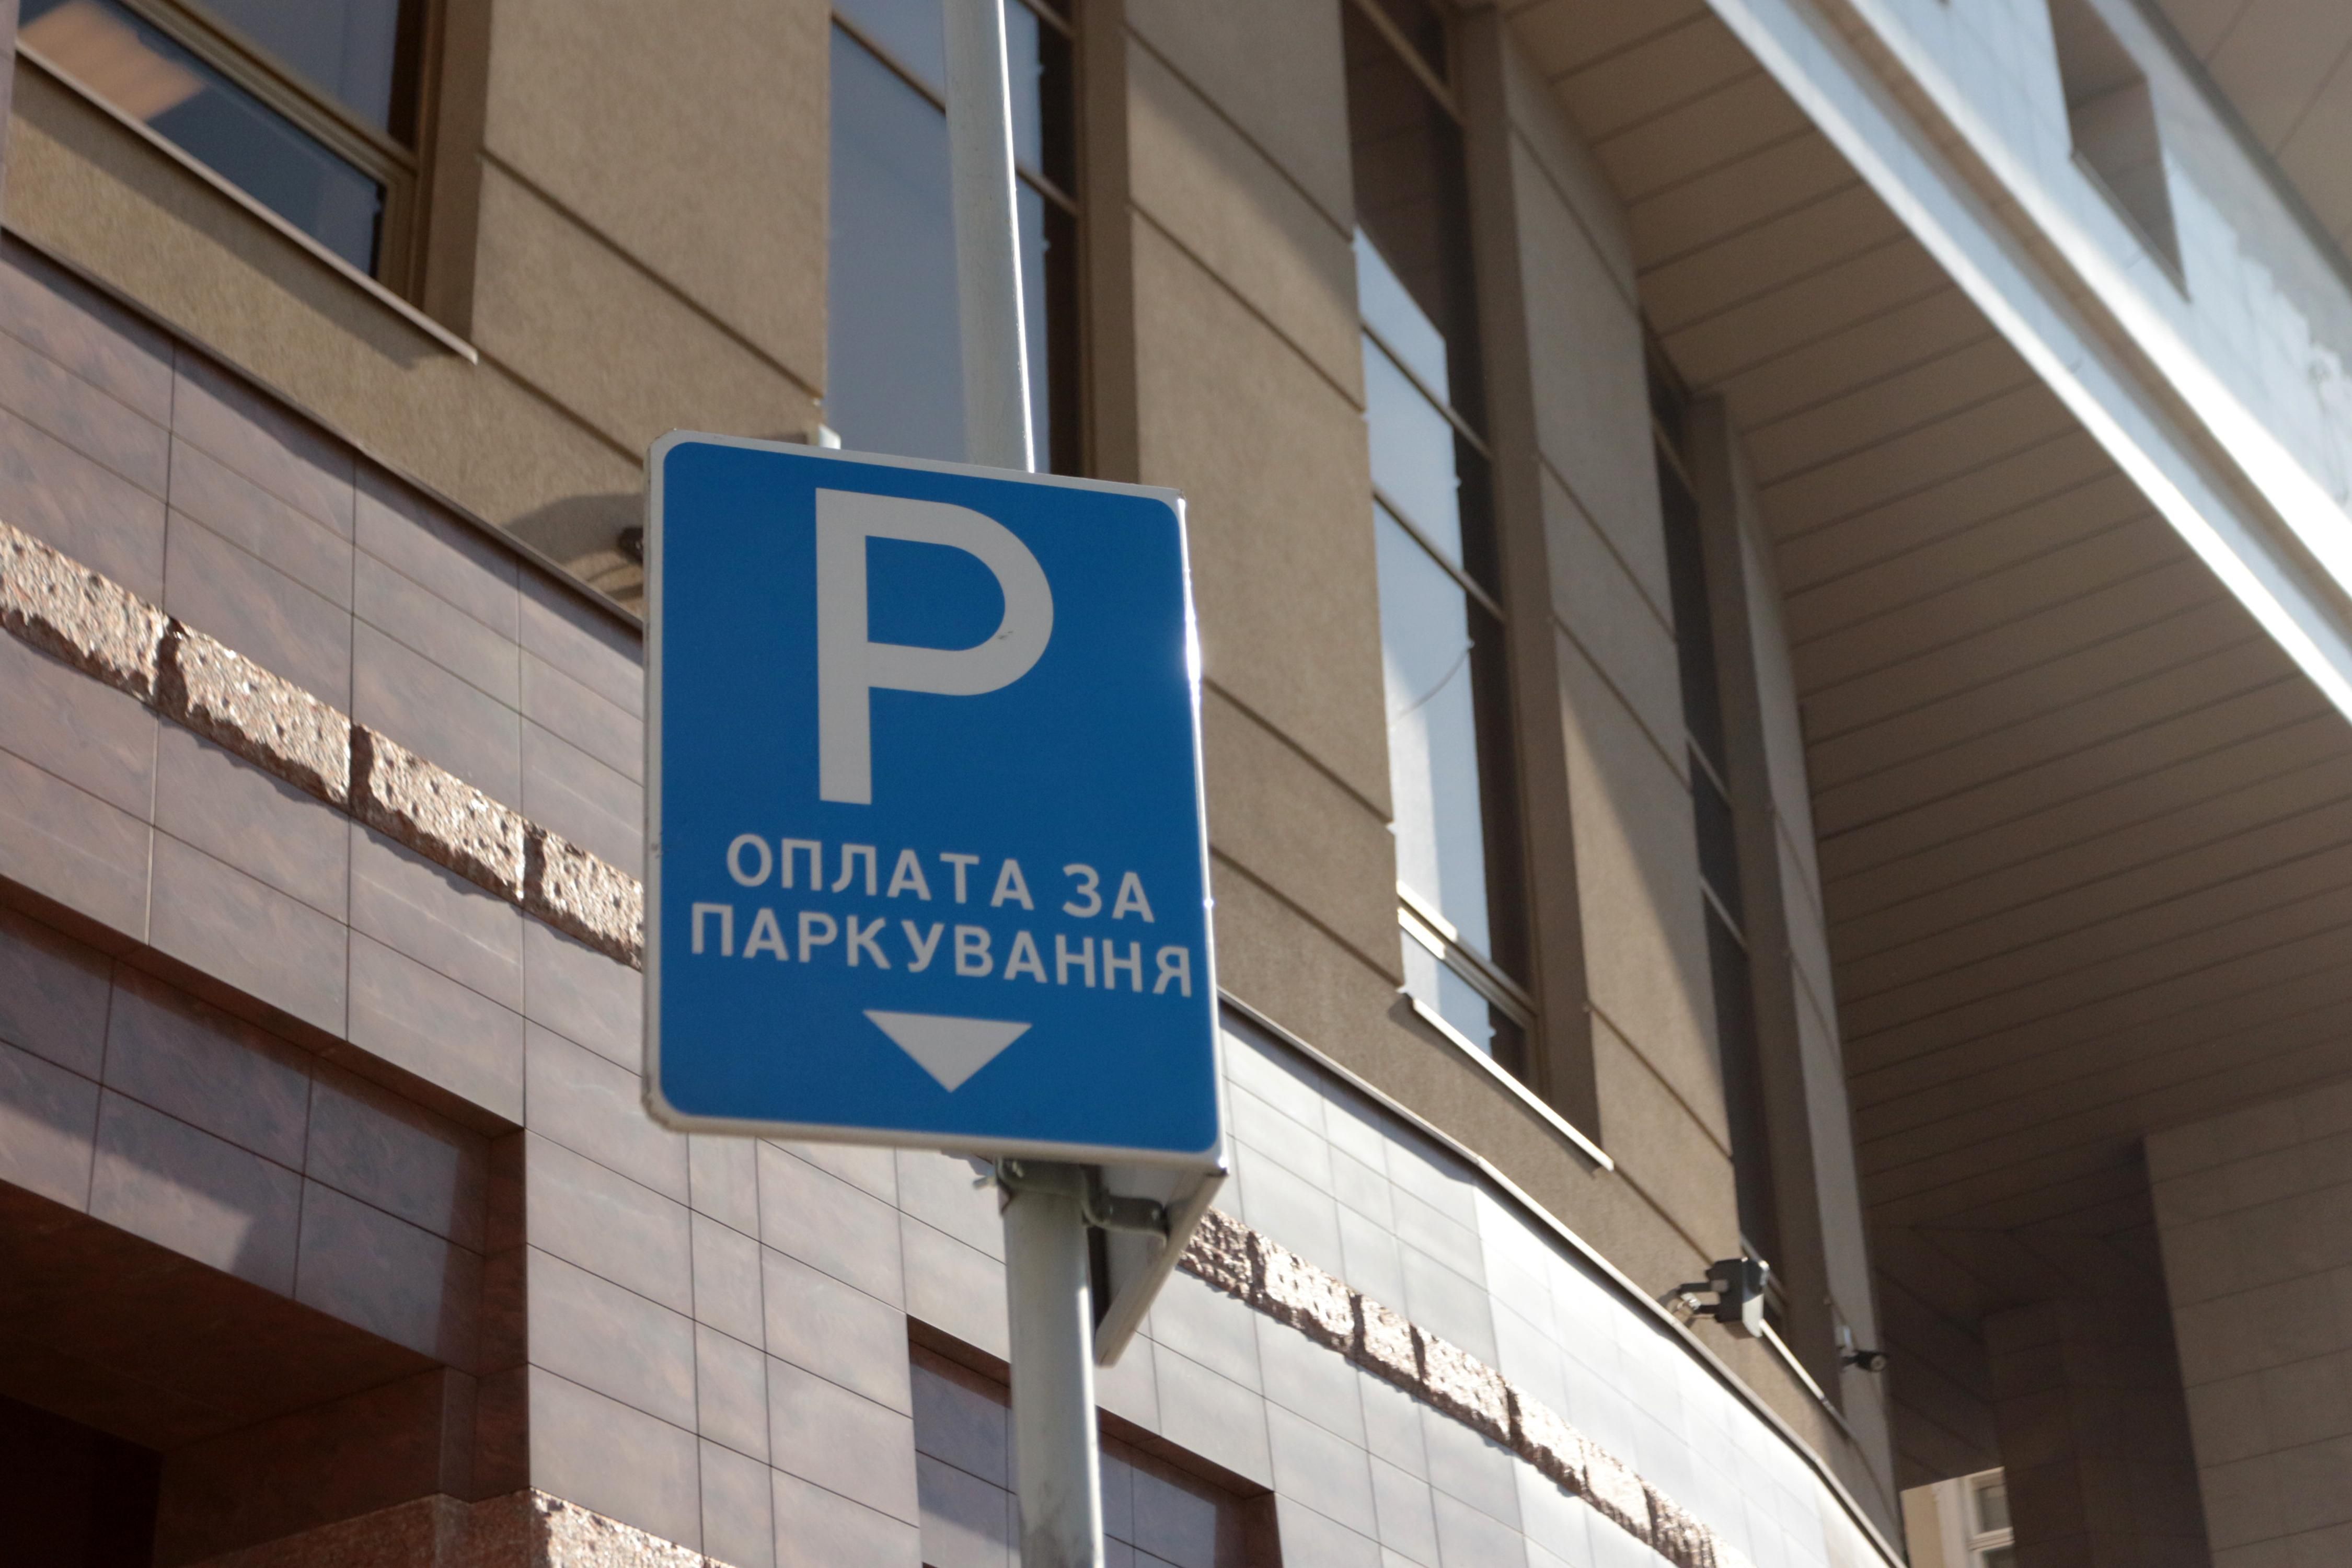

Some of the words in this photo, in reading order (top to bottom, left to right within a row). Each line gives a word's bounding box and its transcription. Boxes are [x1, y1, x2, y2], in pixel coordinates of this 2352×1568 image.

[815, 488, 1054, 805] P
[727, 834, 1034, 910] ОПЛАТА
[1063, 864, 1155, 923] ЗА
[691, 902, 1192, 997] ПАРКУВАННЯ
